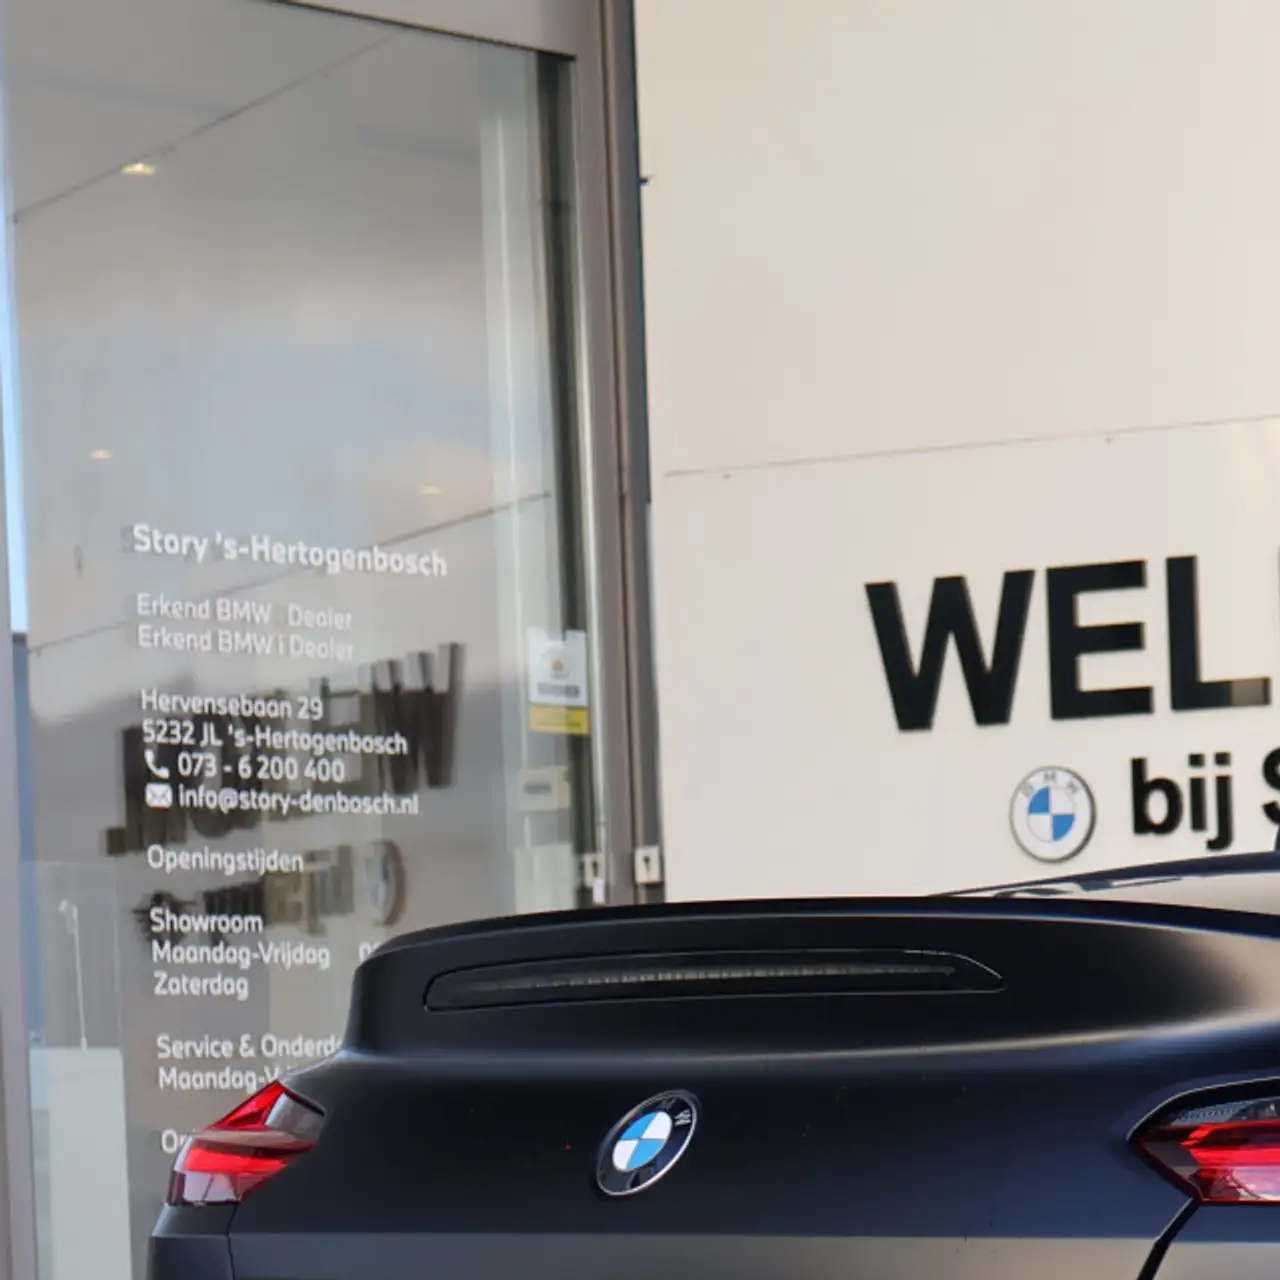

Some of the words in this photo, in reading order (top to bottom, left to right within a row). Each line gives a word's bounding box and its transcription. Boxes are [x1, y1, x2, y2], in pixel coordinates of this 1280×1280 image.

[132, 523, 209, 563] Story
[215, 530, 449, 576] 's-Hertogenbosch
[136, 593, 210, 620] Erkend
[216, 598, 273, 624] BMW
[287, 603, 352, 630] Dealer
[138, 624, 212, 651] Erkend
[217, 629, 273, 655] BMW
[289, 635, 354, 661] Dealer
[141, 689, 293, 719] Hervensebaan
[297, 696, 324, 720] 29
[142, 720, 196, 745] 5232
[199, 724, 223, 748] JL
[228, 724, 409, 756] 's-Hertogenbosch
[177, 752, 218, 777] 073
[238, 755, 252, 779] 6
[257, 756, 299, 780] 200
[304, 758, 346, 782] 400
[178, 784, 420, 815] info@story-denbosch.nl
[1130, 751, 1234, 851] bij
[147, 844, 305, 876] Openingstijden
[150, 907, 264, 934] Showroom
[152, 940, 332, 971] Maandag-Vrijdag
[153, 970, 250, 1001] Zaterdag
[156, 1034, 234, 1060] Service
[239, 1034, 255, 1058] &
[158, 1065, 291, 1093] Maandag-V
